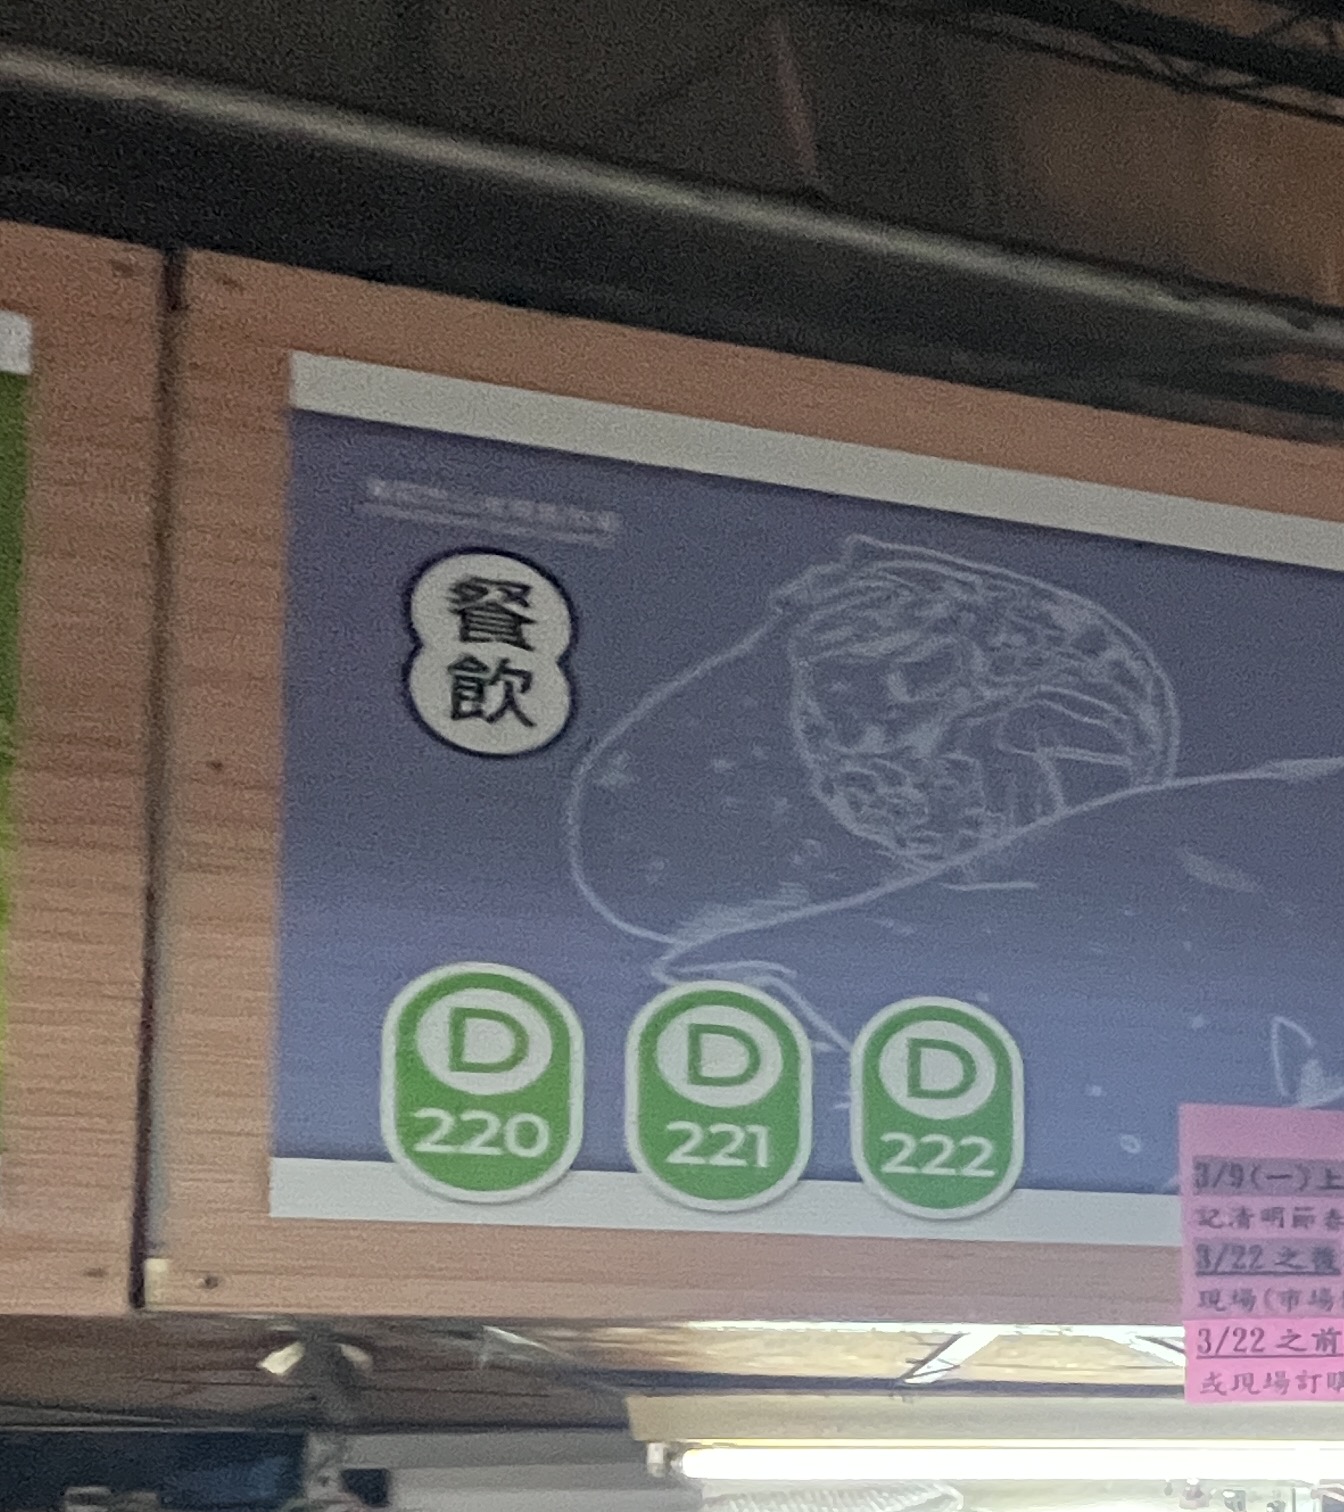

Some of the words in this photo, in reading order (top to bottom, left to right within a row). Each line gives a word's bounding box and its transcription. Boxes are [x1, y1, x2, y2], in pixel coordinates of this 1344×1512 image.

[447, 576, 536, 728] 餐飲
[450, 1008, 528, 1074] D
[687, 1022, 761, 1086] D
[906, 1038, 977, 1100] D
[412, 1110, 550, 1158] 220
[666, 1123, 772, 1168] 221
[880, 1133, 996, 1178] 222
